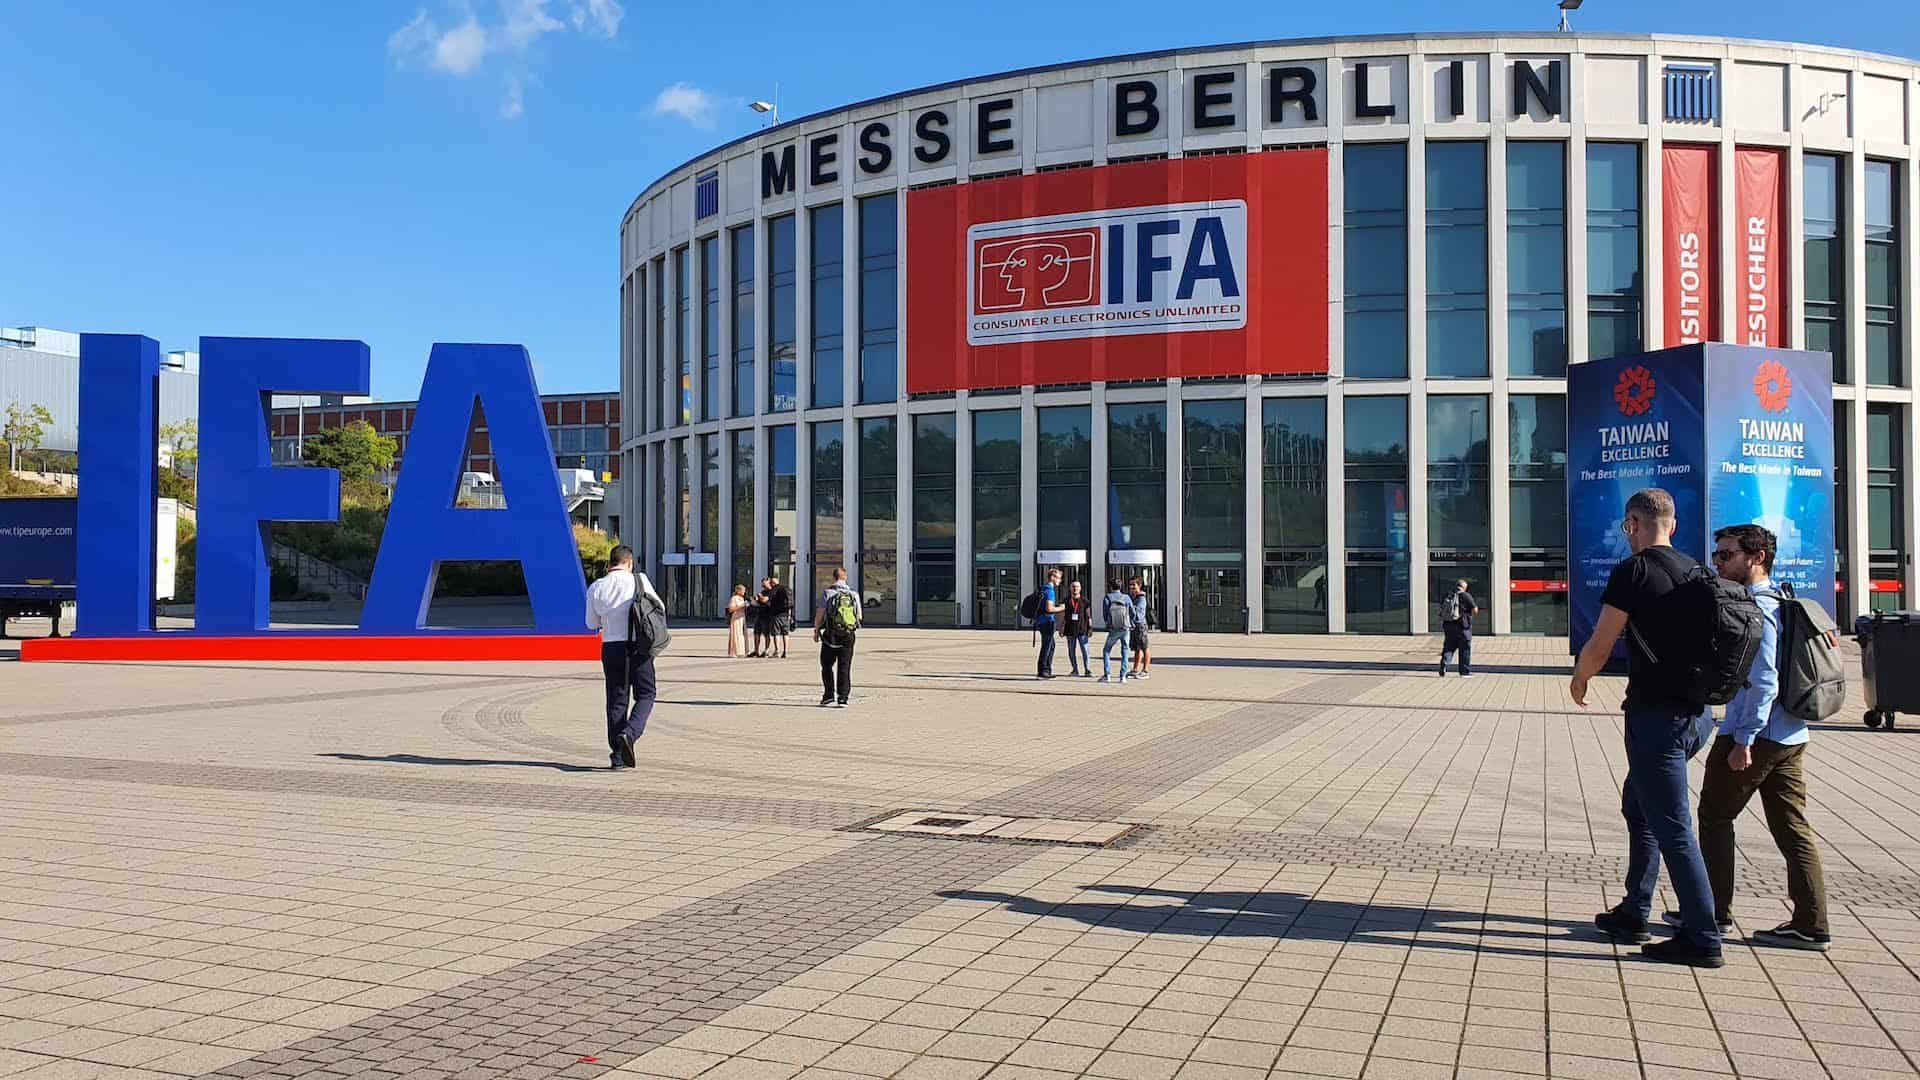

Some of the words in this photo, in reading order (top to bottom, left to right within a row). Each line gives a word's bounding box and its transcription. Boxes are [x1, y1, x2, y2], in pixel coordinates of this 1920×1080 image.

[762, 99, 1015, 199] MESSE
[1115, 60, 1562, 137] BERLIN
[1107, 216, 1241, 305] IFA
[1748, 216, 1767, 347] ESUCHER
[973, 315, 1050, 332] CONSUMER
[1053, 309, 1151, 326] ELECTRONICS
[1155, 303, 1241, 319] UNLIMITED
[1598, 421, 1669, 447] TAIWAN
[1739, 418, 1804, 442] TAIWAN
[1602, 445, 1670, 463] EXCELLENCE
[1742, 442, 1804, 459] EXCELLENCE
[1581, 470, 1596, 481] The
[1598, 469, 1616, 480] Best
[1618, 467, 1643, 478] Made
[1646, 466, 1655, 476] in
[1657, 464, 1691, 475] Taiwan
[1721, 461, 1737, 473] The
[1738, 463, 1757, 475] Best
[1793, 466, 1822, 478] Taiwan
[75, 332, 588, 634] IFA
